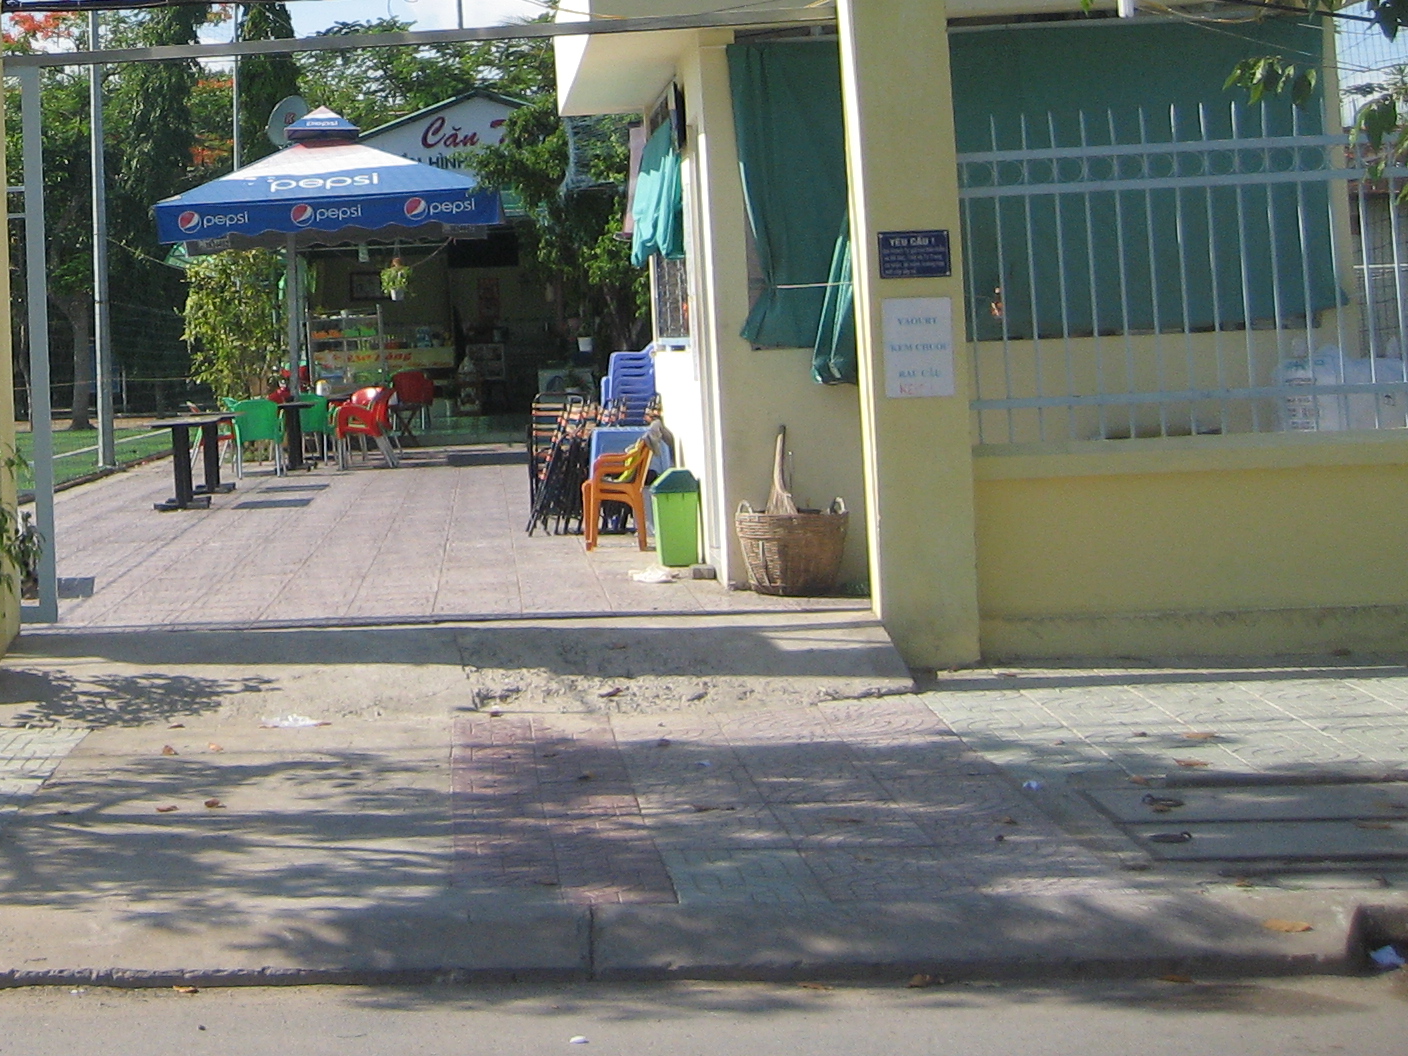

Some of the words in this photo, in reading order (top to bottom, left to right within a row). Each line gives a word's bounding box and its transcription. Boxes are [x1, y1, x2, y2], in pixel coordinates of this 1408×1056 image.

[421, 116, 480, 149] Căn
[270, 172, 379, 193] pepsi
[315, 204, 362, 222] pepsi
[429, 198, 476, 216] pepsi
[202, 211, 249, 229] pepsi
